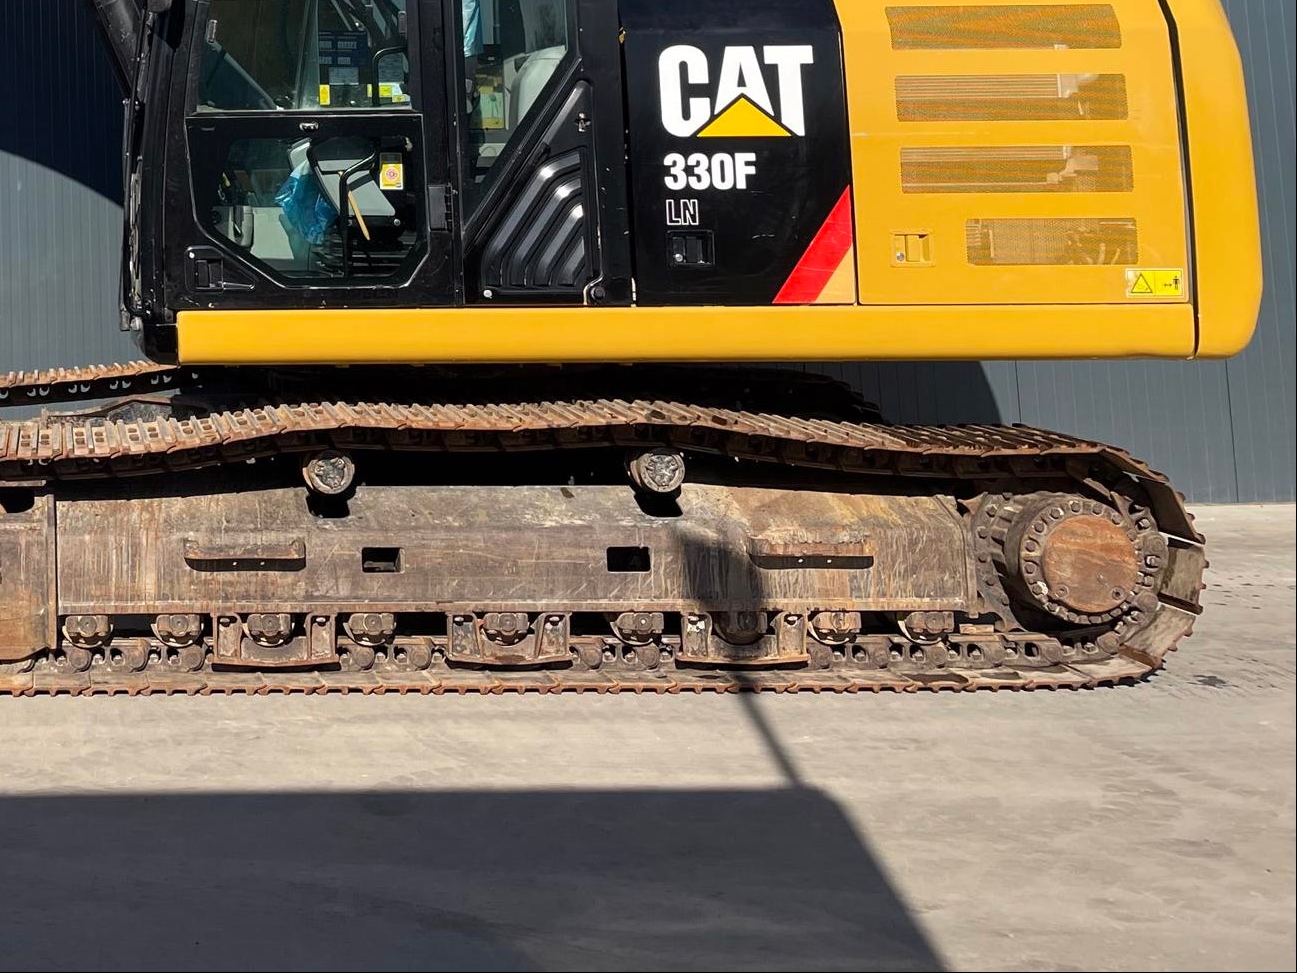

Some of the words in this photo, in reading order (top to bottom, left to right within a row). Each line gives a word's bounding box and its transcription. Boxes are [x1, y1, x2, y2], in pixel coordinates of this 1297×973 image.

[658, 44, 814, 137] CAT
[663, 152, 756, 190] 330F
[665, 199, 699, 225] LN
